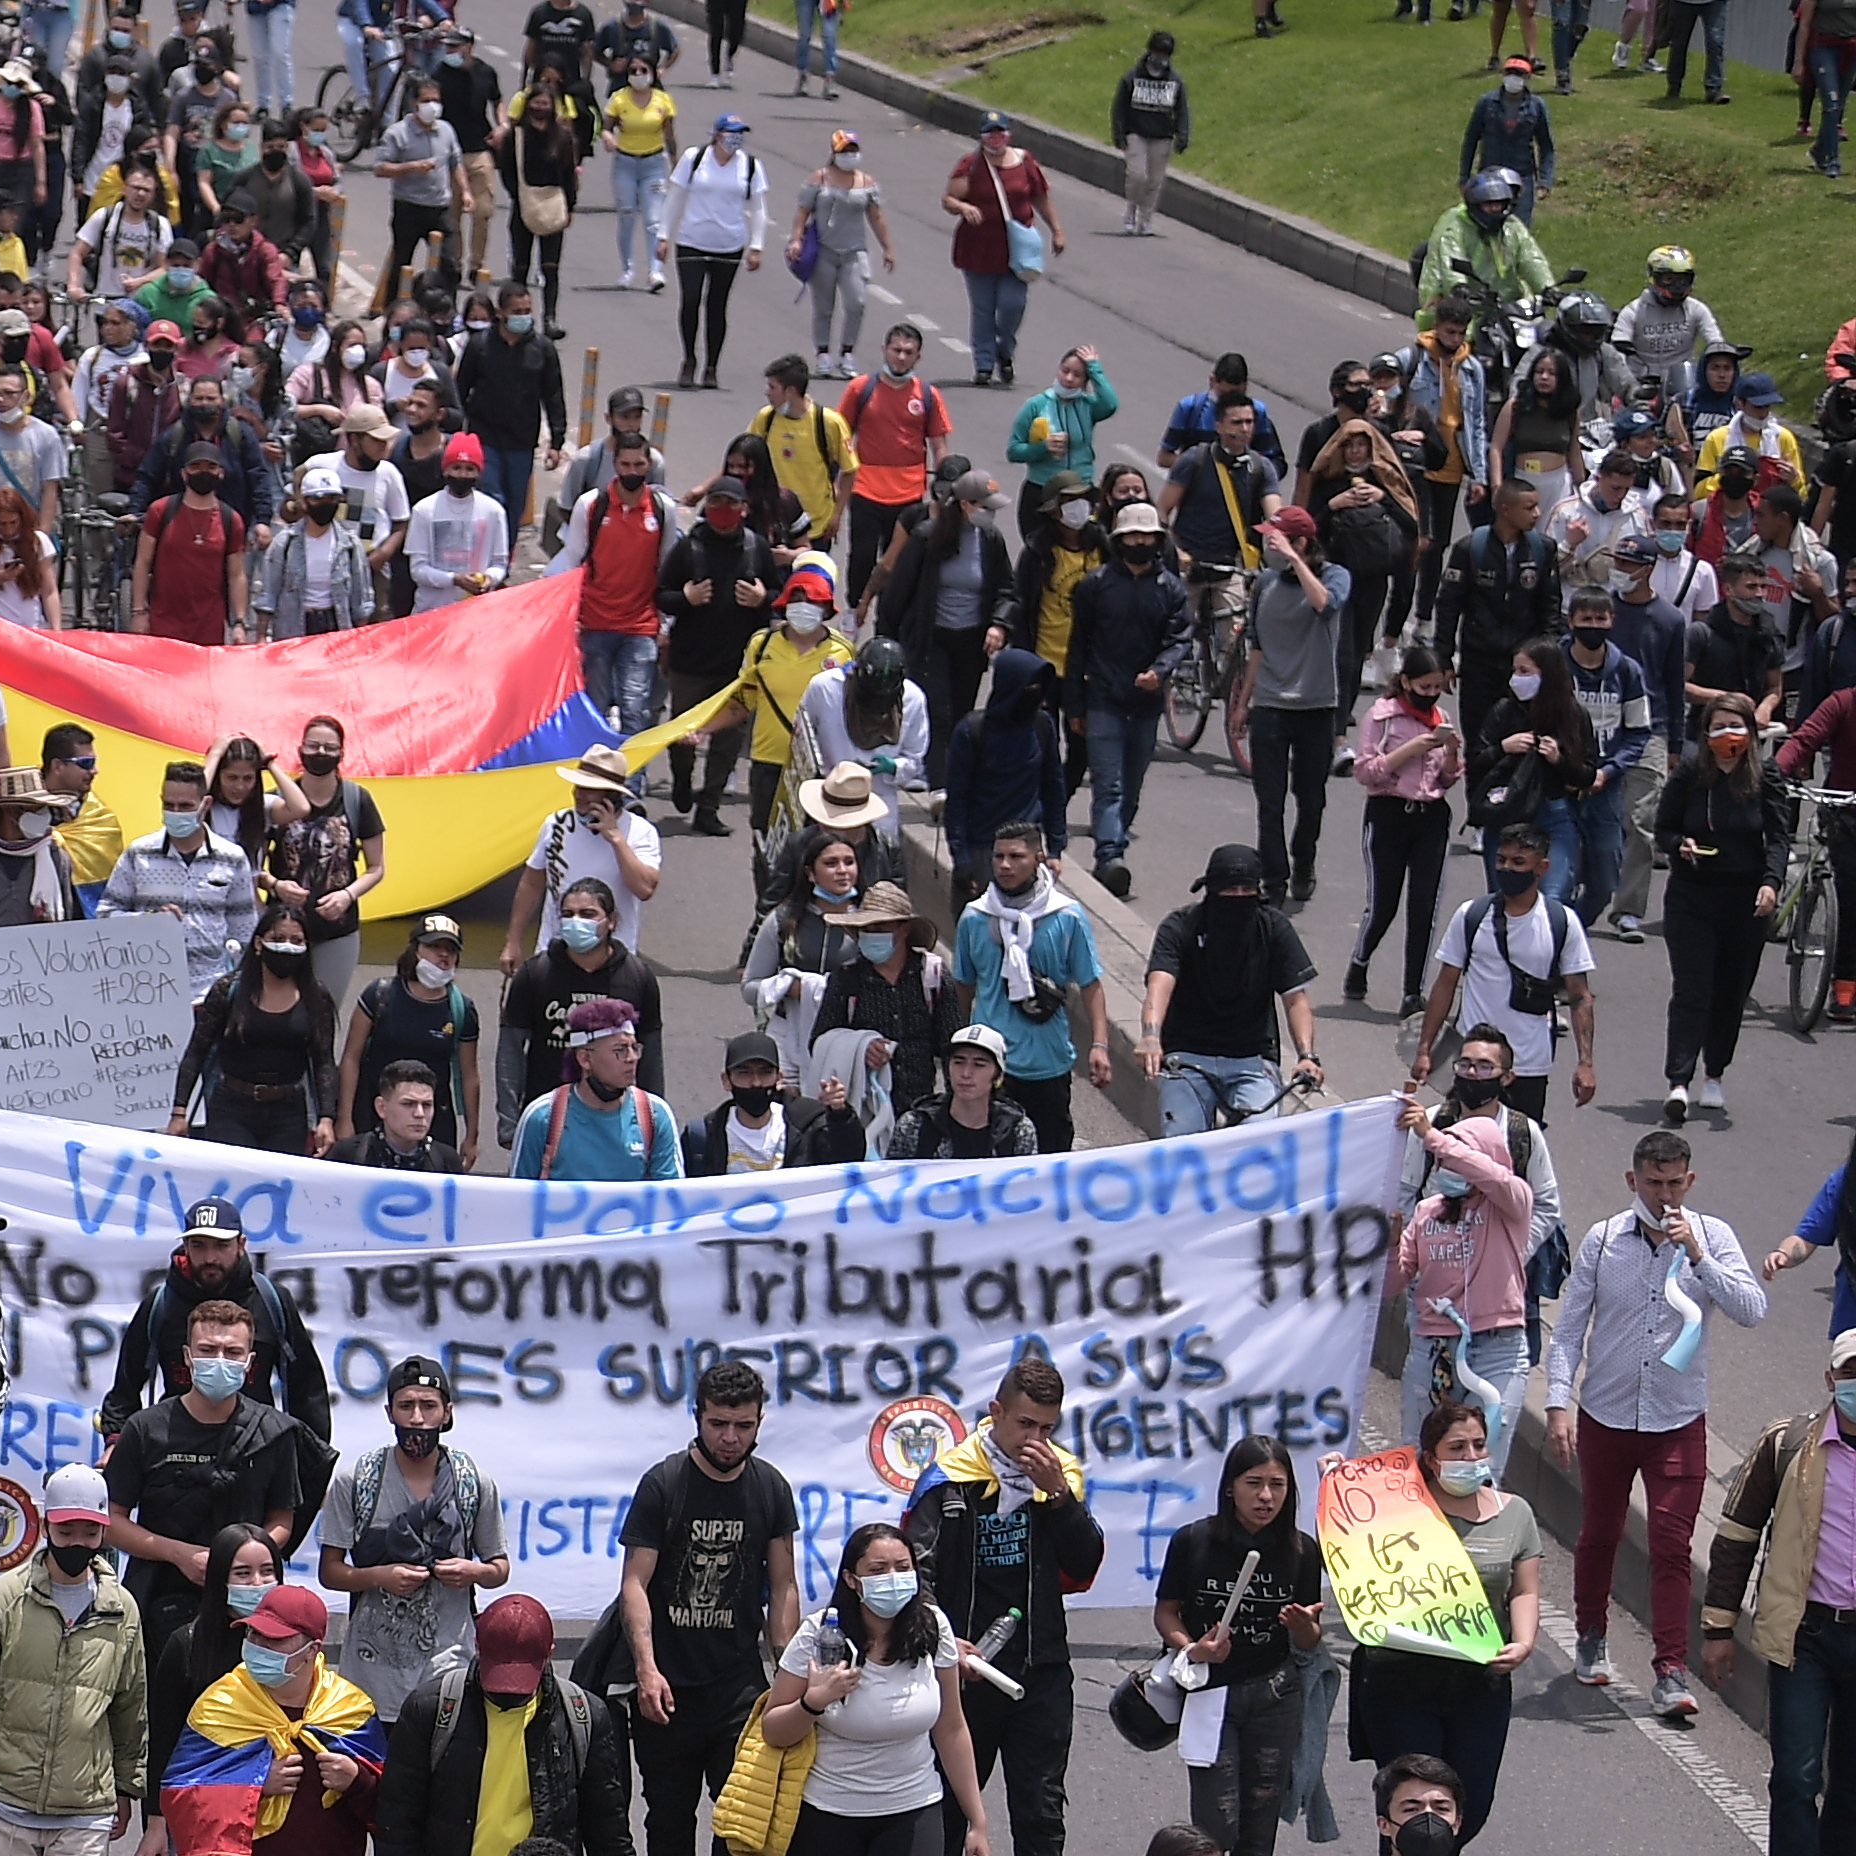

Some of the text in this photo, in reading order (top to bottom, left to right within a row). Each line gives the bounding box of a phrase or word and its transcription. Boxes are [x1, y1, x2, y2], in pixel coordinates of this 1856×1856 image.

[27, 931, 172, 978] Voluntarios
[92, 969, 179, 1005] #28A
[90, 1033, 175, 1064] REFORMA
[99, 1022, 118, 1041] a
[125, 1014, 146, 1038] la
[363, 1176, 459, 1243] el
[344, 1250, 668, 1330] reforma
[698, 1229, 1180, 1330] Tributaria
[441, 1338, 565, 1409] ES
[596, 1338, 965, 1412] SUPERIOR
[1081, 1324, 1232, 1394] SUS
[1328, 1479, 1376, 1536] NO
[1326, 1540, 1350, 1579] A
